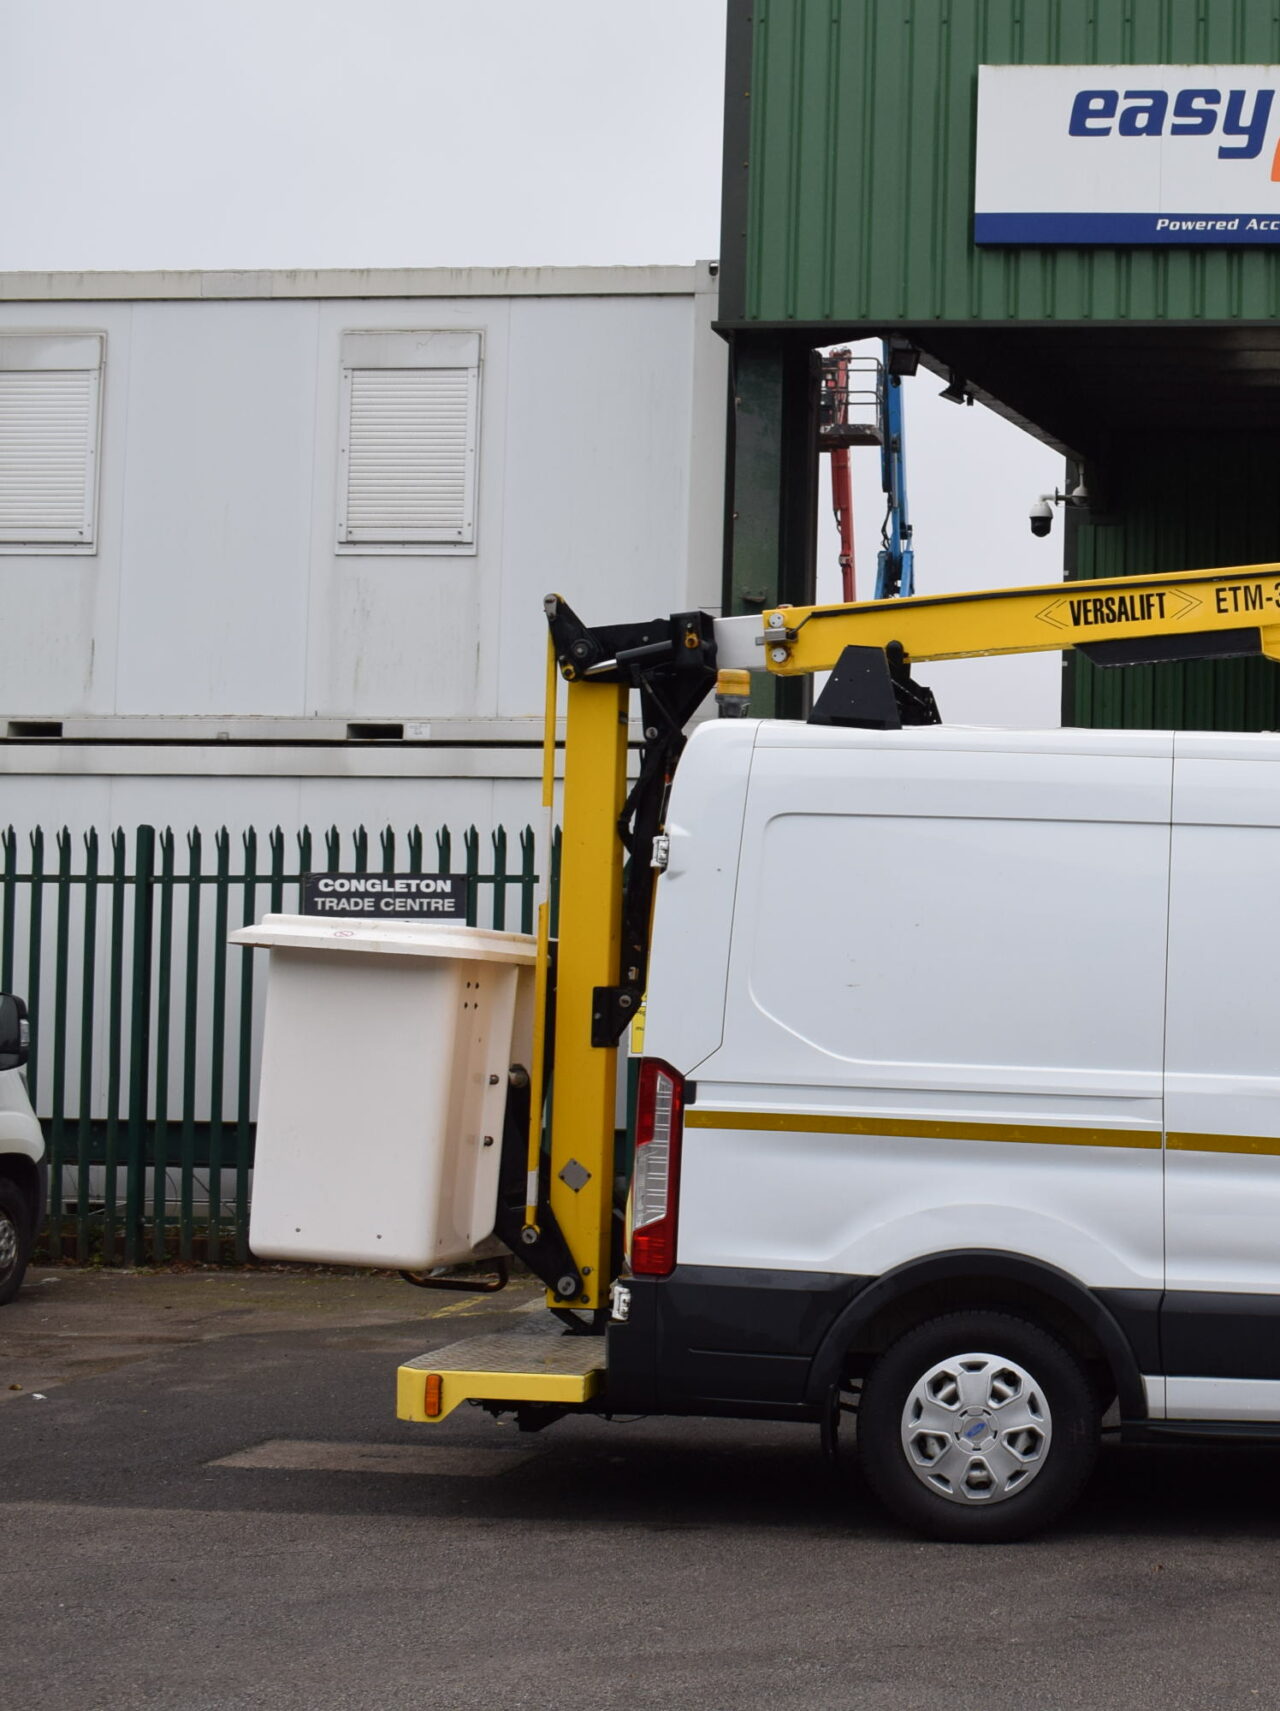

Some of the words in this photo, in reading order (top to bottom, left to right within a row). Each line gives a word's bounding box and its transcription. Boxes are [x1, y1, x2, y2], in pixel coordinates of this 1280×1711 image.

[1155, 218, 1240, 231] Powered
[1069, 592, 1167, 627] VERSALIFT
[318, 878, 452, 893] CONGLETON
[314, 897, 375, 911] TRADE
[380, 898, 456, 912] CENTRE
